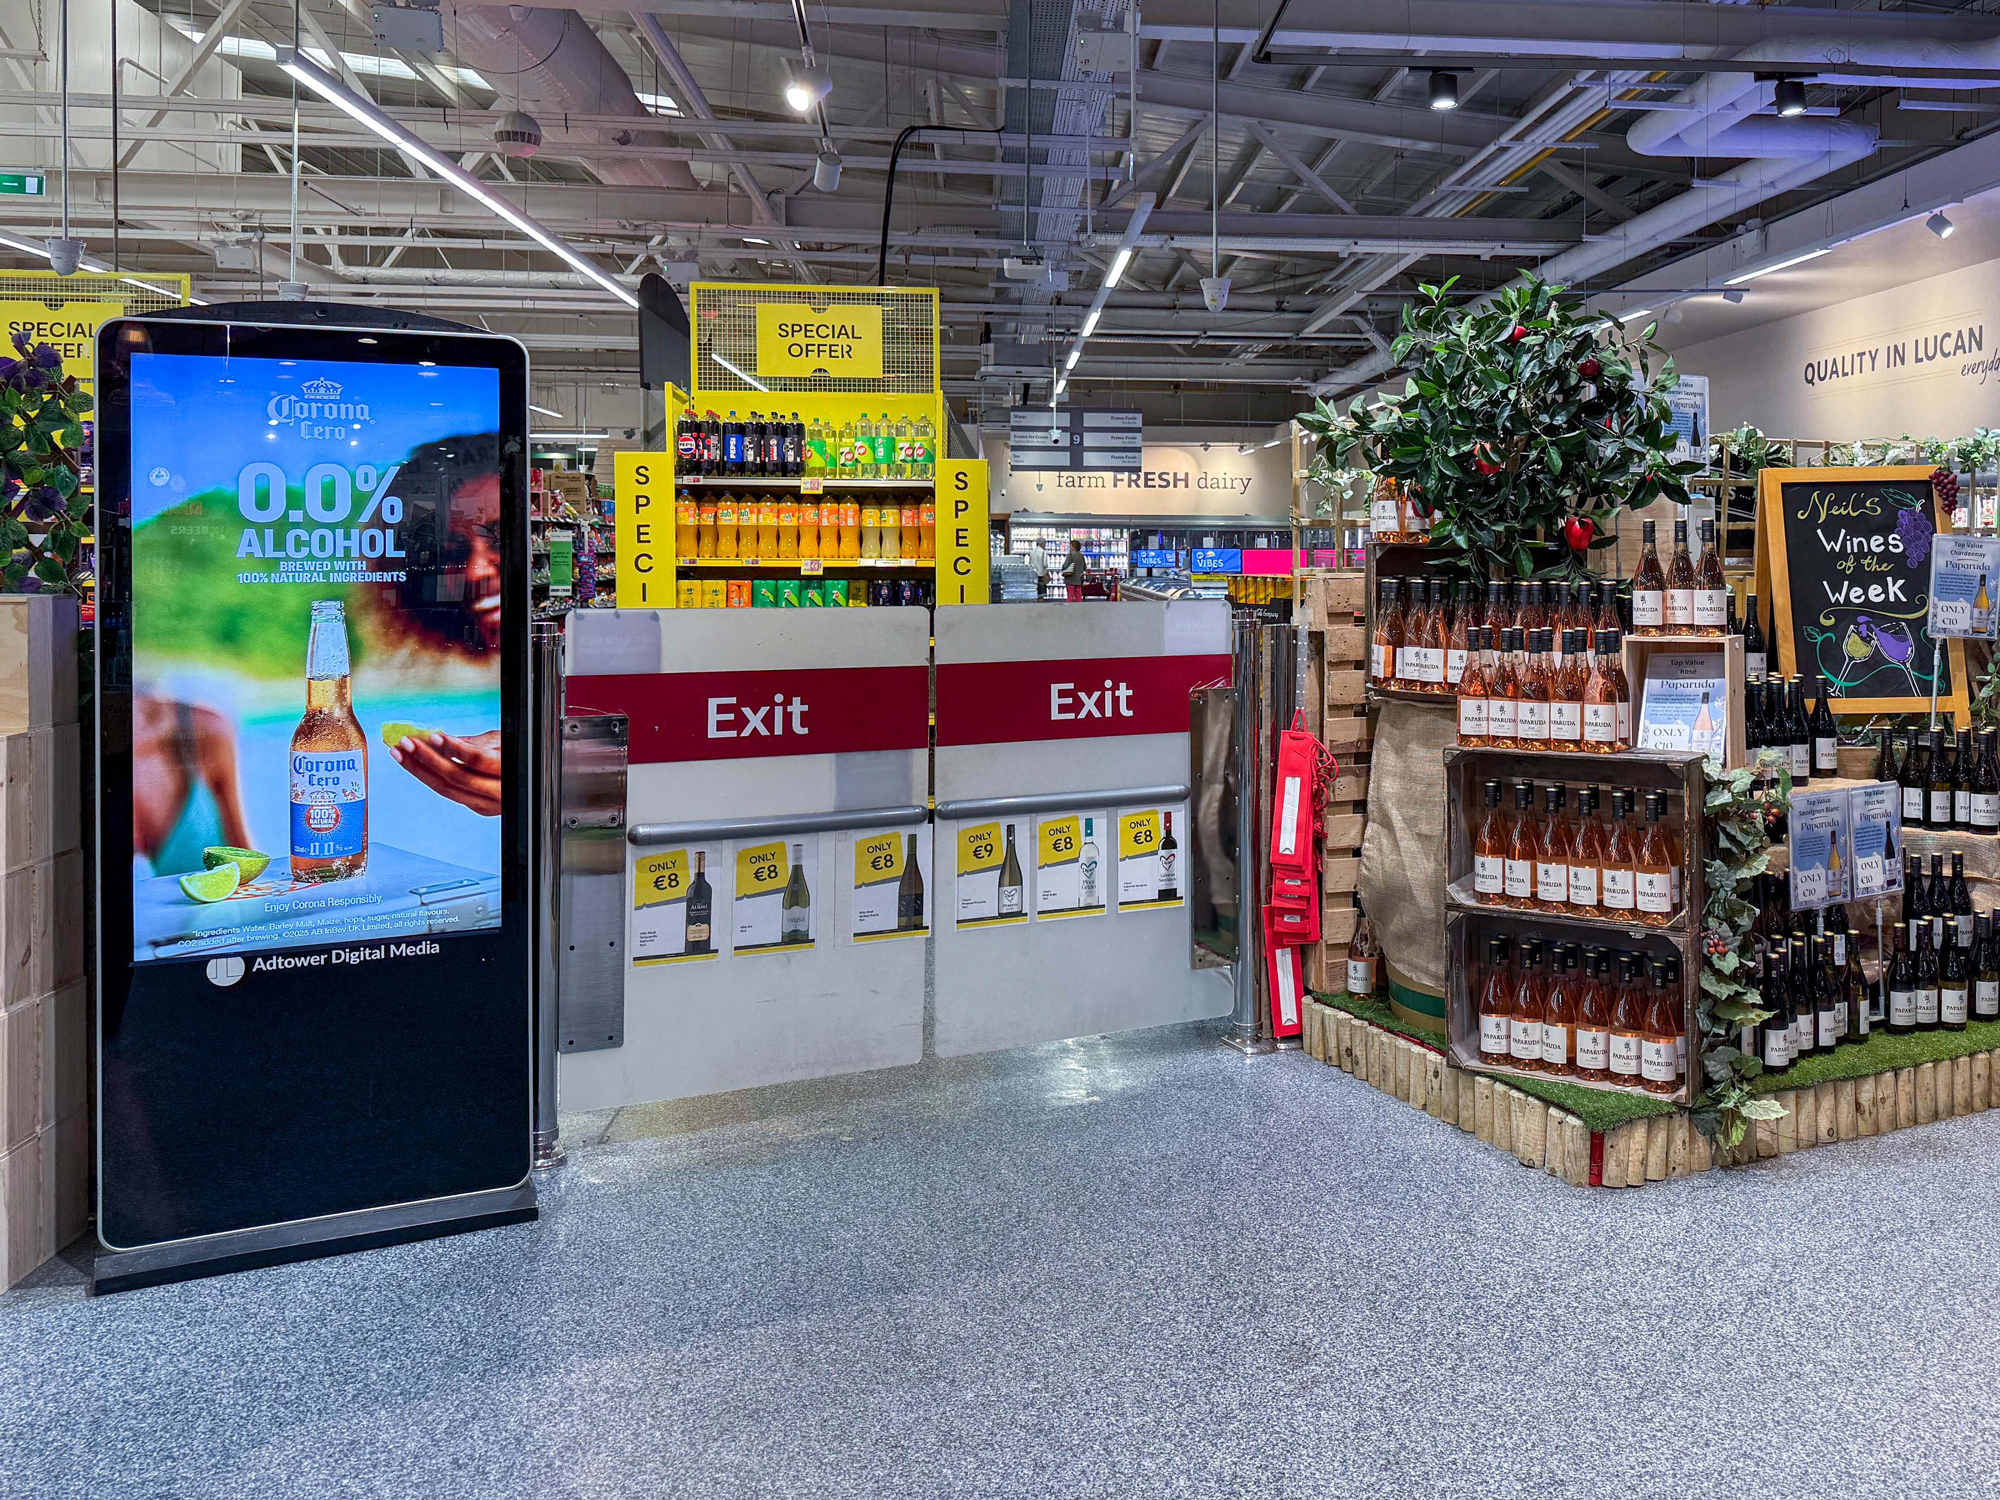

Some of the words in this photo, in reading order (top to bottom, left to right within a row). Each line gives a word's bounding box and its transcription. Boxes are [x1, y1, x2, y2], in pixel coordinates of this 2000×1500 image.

[778, 323, 862, 340] SPECIAL
[787, 343, 853, 359] OFFER
[1804, 348, 1879, 387] QUALITY
[1886, 342, 1906, 368] IN
[1914, 324, 1983, 364] LUCAN
[1960, 347, 2000, 385] everyda
[267, 394, 372, 427] Corona
[301, 420, 346, 440] Cero
[1073, 435, 1080, 445] 9
[729, 437, 737, 460] PEPSI
[1056, 470, 1106, 488] farm
[1112, 471, 1189, 489] FRESH
[1197, 472, 1252, 495] dairy
[238, 462, 403, 524] 0.0%
[1797, 490, 1882, 524] Neil's
[237, 528, 406, 558] ALCOHOL
[1816, 528, 1904, 553] Wines
[1954, 541, 1966, 549] Top
[1966, 542, 1984, 550] Value
[1141, 557, 1162, 565] VIBES
[1950, 550, 1987, 559] Chardonnay
[280, 561, 330, 571] BREWED
[333, 560, 367, 571] WITH
[1197, 558, 1224, 568] VIBES
[1836, 554, 1857, 575] of
[1860, 555, 1895, 573] the
[1945, 560, 1991, 571] Paparuda
[237, 573, 268, 584] 100%
[271, 572, 326, 584] NATURAL
[329, 571, 407, 583] INGREDIENTS
[1940, 604, 1967, 614] ONLY
[1942, 617, 1958, 626] €10
[1670, 659, 1683, 667] Top
[1660, 680, 1715, 690] Paparuda
[1051, 679, 1134, 721] Exit
[707, 693, 809, 739] Exit
[1653, 728, 1685, 737] ONLY
[292, 754, 357, 778] Corona
[308, 774, 340, 787] Cero
[1863, 790, 1873, 798] Top
[1806, 799, 1817, 807] Top
[309, 808, 337, 819] 100%
[1798, 808, 1825, 817] Sauvignon
[1825, 805, 1840, 813] Blanc
[1859, 808, 1892, 823] Paparuda
[1048, 824, 1072, 837] ONLY
[1129, 817, 1152, 830] ONLY
[1800, 818, 1840, 832] Paparuda
[968, 830, 993, 843] ONLY
[1133, 829, 1153, 845] €8
[866, 841, 893, 854] ONLY
[972, 843, 994, 860] €9
[1052, 836, 1074, 853] €8
[749, 851, 777, 865] ONLY
[870, 853, 895, 871] €8
[648, 859, 678, 873] ONLY
[1860, 860, 1880, 871] ONLY
[753, 864, 779, 882] €8
[1800, 873, 1823, 884] ONLY
[653, 872, 680, 891] €8
[264, 900, 290, 914] Enjoy
[292, 898, 326, 911] Corona
[327, 893, 384, 908] Responsibly.
[241, 925, 268, 934] Water,
[269, 922, 294, 931] Barley
[295, 920, 316, 928] Malt,
[317, 918, 342, 927] Maize,
[344, 916, 366, 924] hops,
[367, 913, 390, 922] sugar,
[391, 910, 417, 919] natural
[418, 908, 450, 917] flavours.
[177, 940, 197, 948] CO2
[198, 937, 225, 947] added
[226, 936, 245, 944] after
[246, 932, 281, 943] brewing.
[282, 929, 310, 938] ©2025
[310, 927, 323, 935] AB
[324, 926, 347, 934] InBev
[362, 922, 393, 931] Limited,
[393, 920, 403, 928] all
[404, 918, 426, 928] rights
[426, 915, 461, 925] reserved.
[252, 953, 328, 973] Adtower
[331, 944, 385, 965] Digital
[389, 940, 440, 958] Media
[1483, 1032, 1510, 1040] PAPARUD
[1579, 1047, 1608, 1056] PAPARUDA
[1643, 1058, 1674, 1068] PAPARUDA
